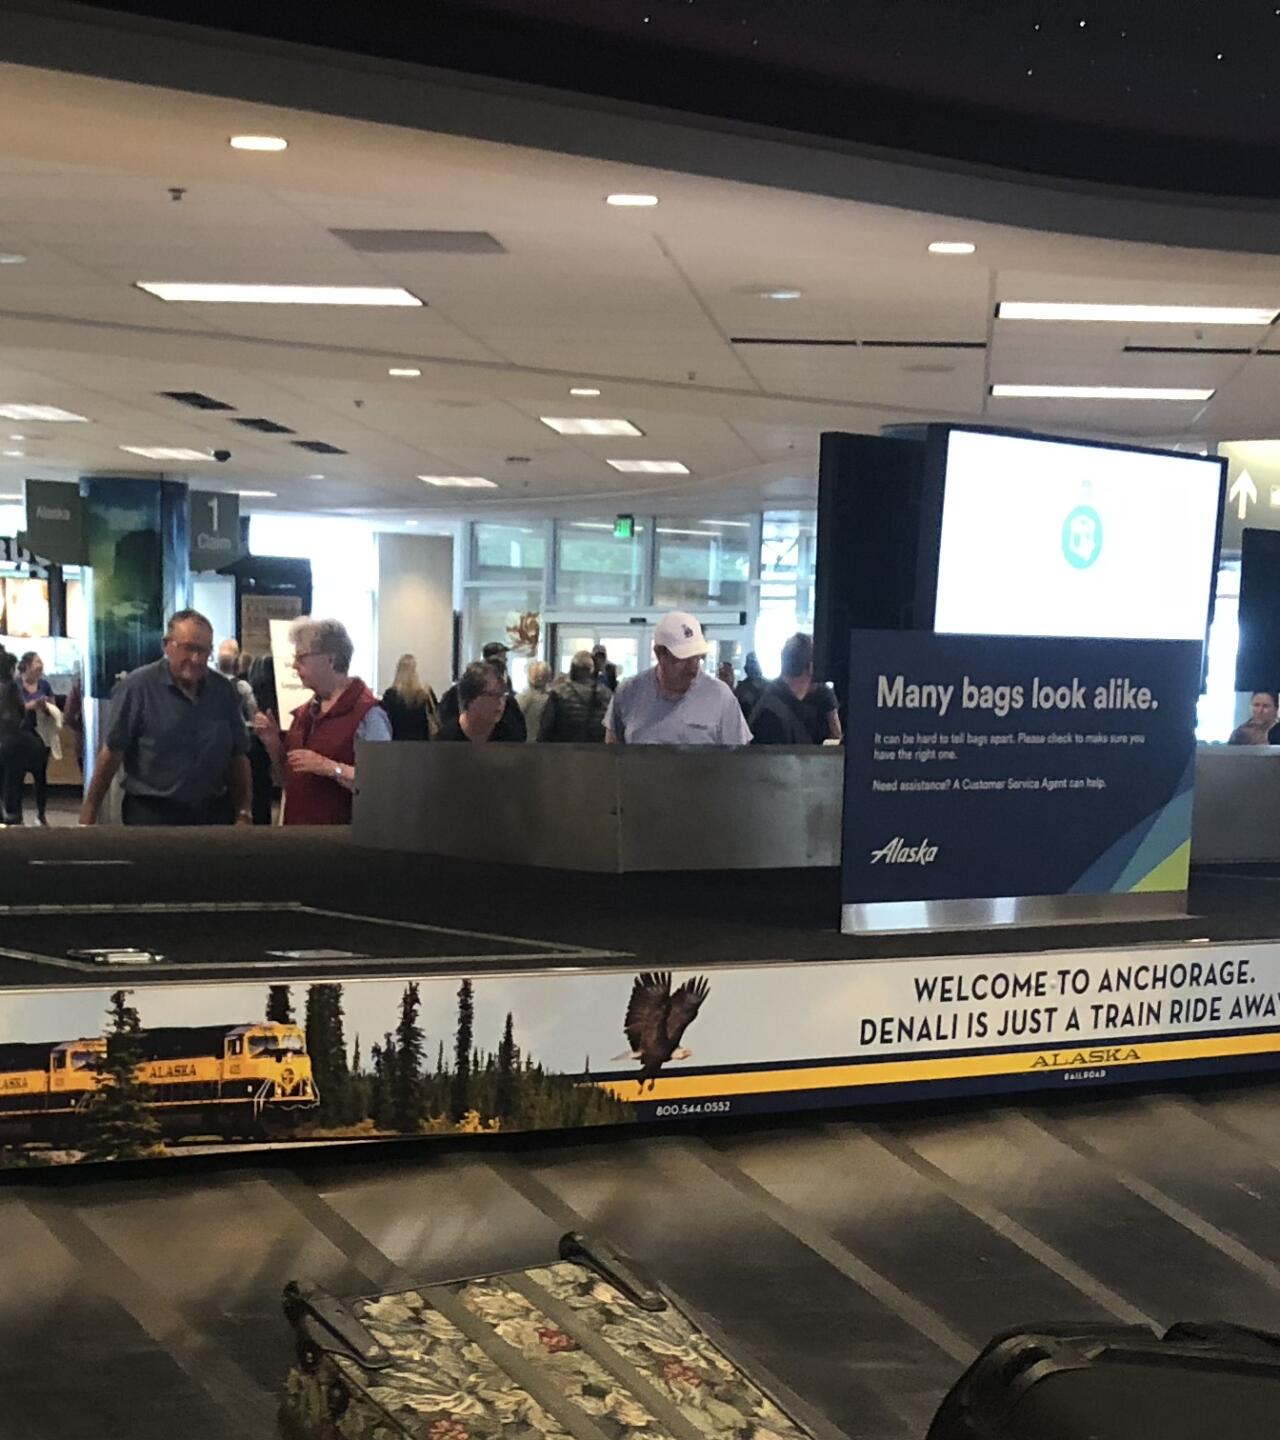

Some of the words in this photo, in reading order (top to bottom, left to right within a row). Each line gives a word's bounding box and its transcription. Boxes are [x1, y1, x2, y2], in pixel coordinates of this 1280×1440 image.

[207, 496, 218, 531] 1
[877, 675, 954, 716] Many
[962, 676, 1024, 717] bags
[1032, 677, 1086, 709] look
[1093, 678, 1159, 710] alike.
[883, 735, 900, 744] can
[902, 732, 915, 744] be
[916, 732, 937, 744] hard
[940, 733, 949, 744] to
[951, 732, 965, 744] tell
[967, 732, 988, 747] bags
[990, 733, 1015, 746] apart.
[1018, 732, 1046, 744] Please
[1047, 732, 1073, 744] check
[1075, 733, 1084, 744] to
[1085, 732, 1109, 744] make
[1110, 734, 1128, 744] sure
[1129, 735, 1145, 746] you
[873, 748, 896, 760] have
[898, 749, 912, 760] the
[915, 749, 936, 762] right
[938, 751, 958, 760] one.
[872, 779, 898, 791] Need
[900, 779, 951, 791] assistance?
[952, 779, 960, 790] A
[962, 778, 1006, 790] Customer
[1007, 778, 1040, 789] Service
[1041, 777, 1067, 791] Agent
[1068, 780, 1084, 789] can
[870, 836, 939, 865] Alaska
[914, 970, 1048, 1003] WELCOME
[1057, 968, 1090, 996] TO
[1098, 960, 1256, 994] ANCHORAGE.
[860, 1013, 958, 1045] DENALI
[968, 1011, 988, 1038] IS
[997, 1007, 1058, 1036] JUST
[1065, 1006, 1080, 1032] A
[1090, 1000, 1162, 1029] TRAIN
[1170, 996, 1222, 1024] RIDE
[1029, 1048, 1141, 1069] ALASKA
[149, 1064, 197, 1079] ALASKA
[1064, 1069, 1107, 1081] RAILROAD
[655, 1101, 731, 1117] 800.544.0552
